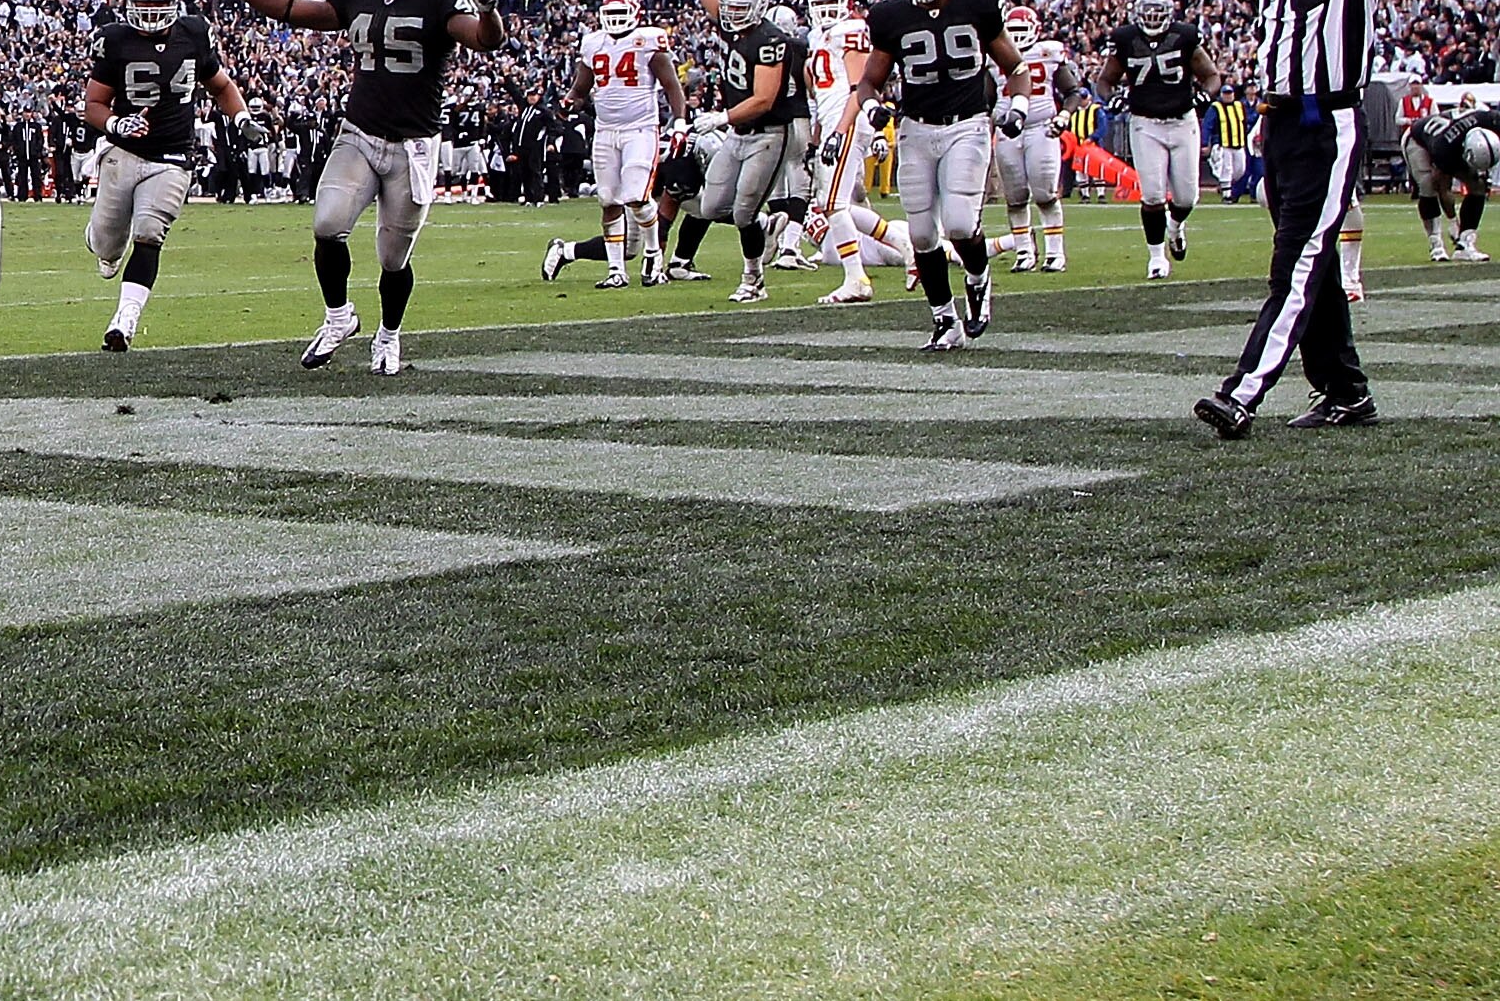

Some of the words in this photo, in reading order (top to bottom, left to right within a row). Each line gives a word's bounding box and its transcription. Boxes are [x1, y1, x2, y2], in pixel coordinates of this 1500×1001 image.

[349, 13, 424, 74] 45
[759, 42, 787, 64] 68
[901, 24, 983, 85] 29
[125, 59, 196, 107] 64
[592, 51, 639, 87] 94
[1127, 50, 1184, 86] 75
[76, 127, 86, 142] 9
[459, 111, 481, 127] 74
